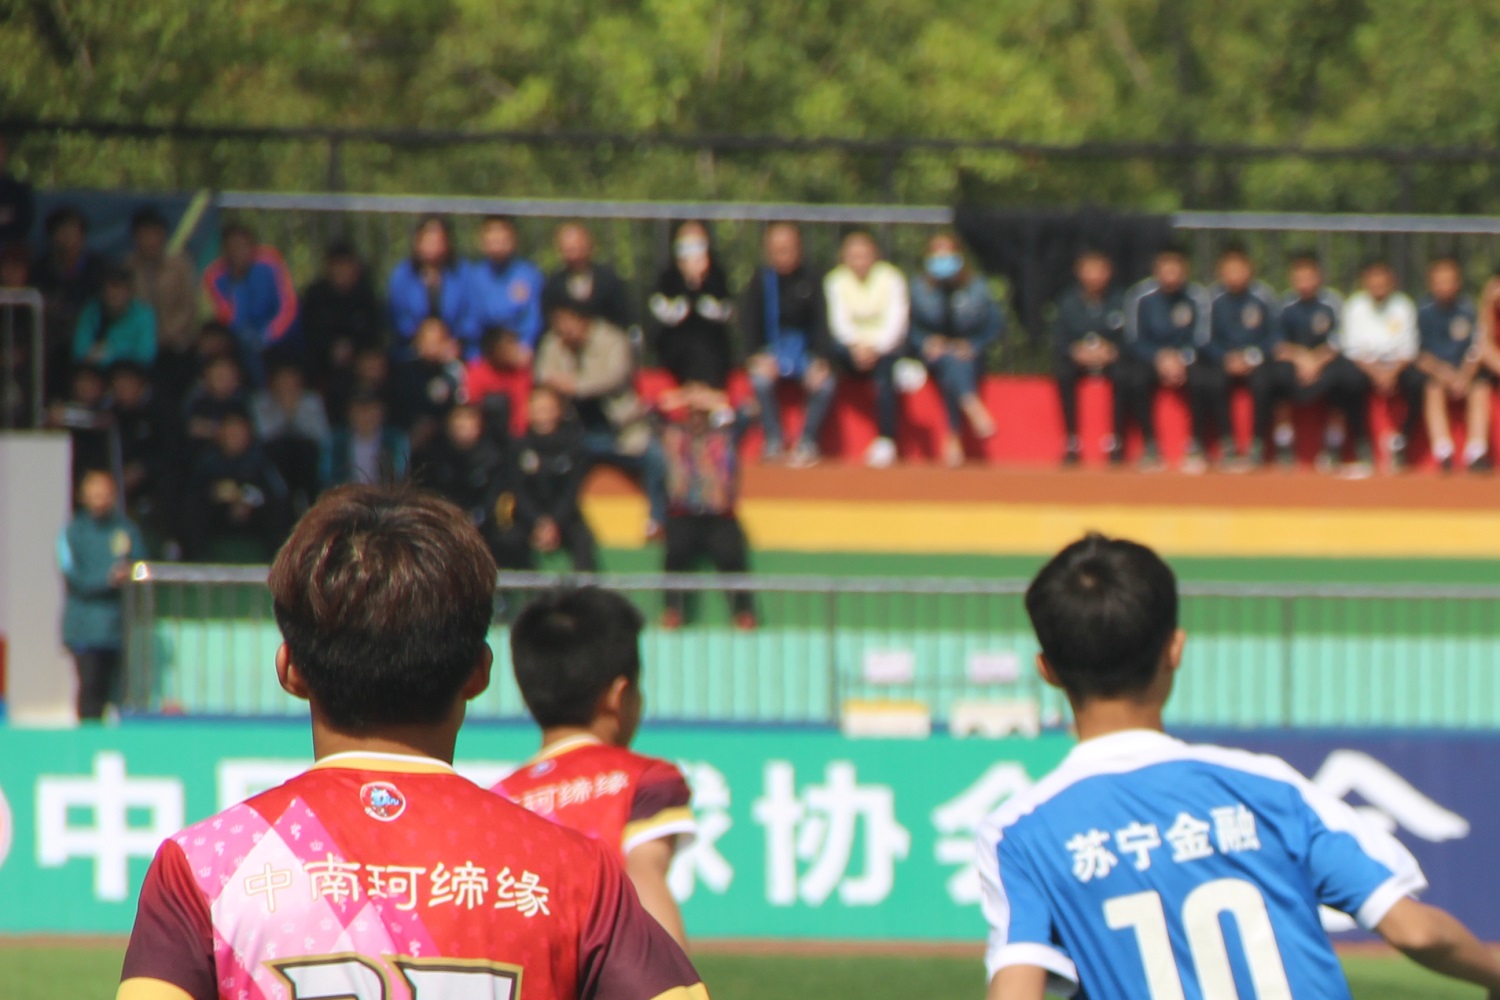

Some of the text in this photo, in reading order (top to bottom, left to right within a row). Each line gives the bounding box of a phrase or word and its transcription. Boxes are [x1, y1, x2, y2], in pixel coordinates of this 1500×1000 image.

[1064, 802, 1262, 884] 苏宁金融
[243, 851, 552, 918] 中南珂缔缘
